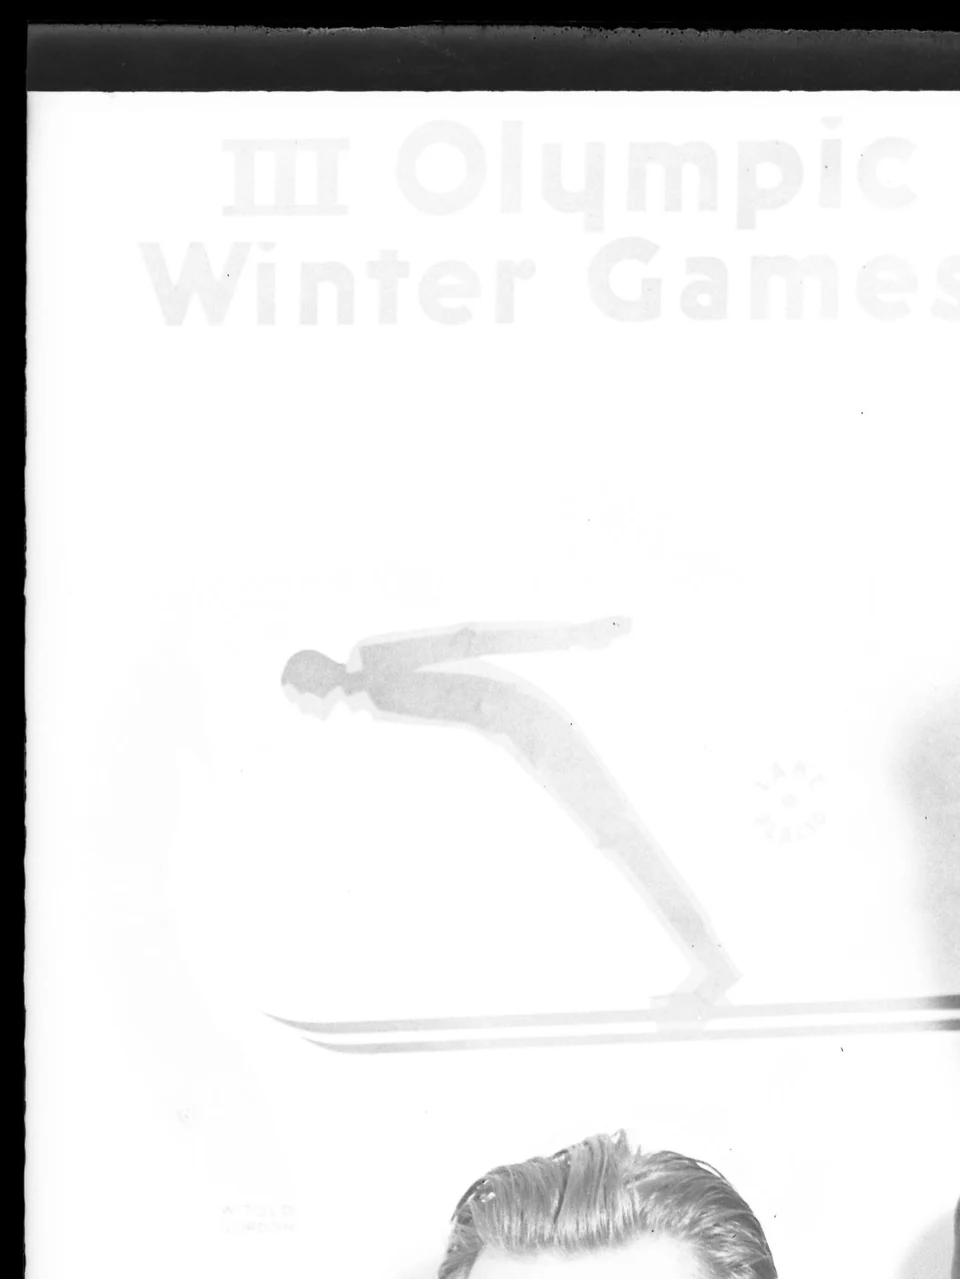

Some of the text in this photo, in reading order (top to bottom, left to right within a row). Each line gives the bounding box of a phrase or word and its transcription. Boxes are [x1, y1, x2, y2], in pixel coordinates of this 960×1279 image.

[221, 116, 917, 232] III Olympic
[138, 241, 536, 327] Winter
